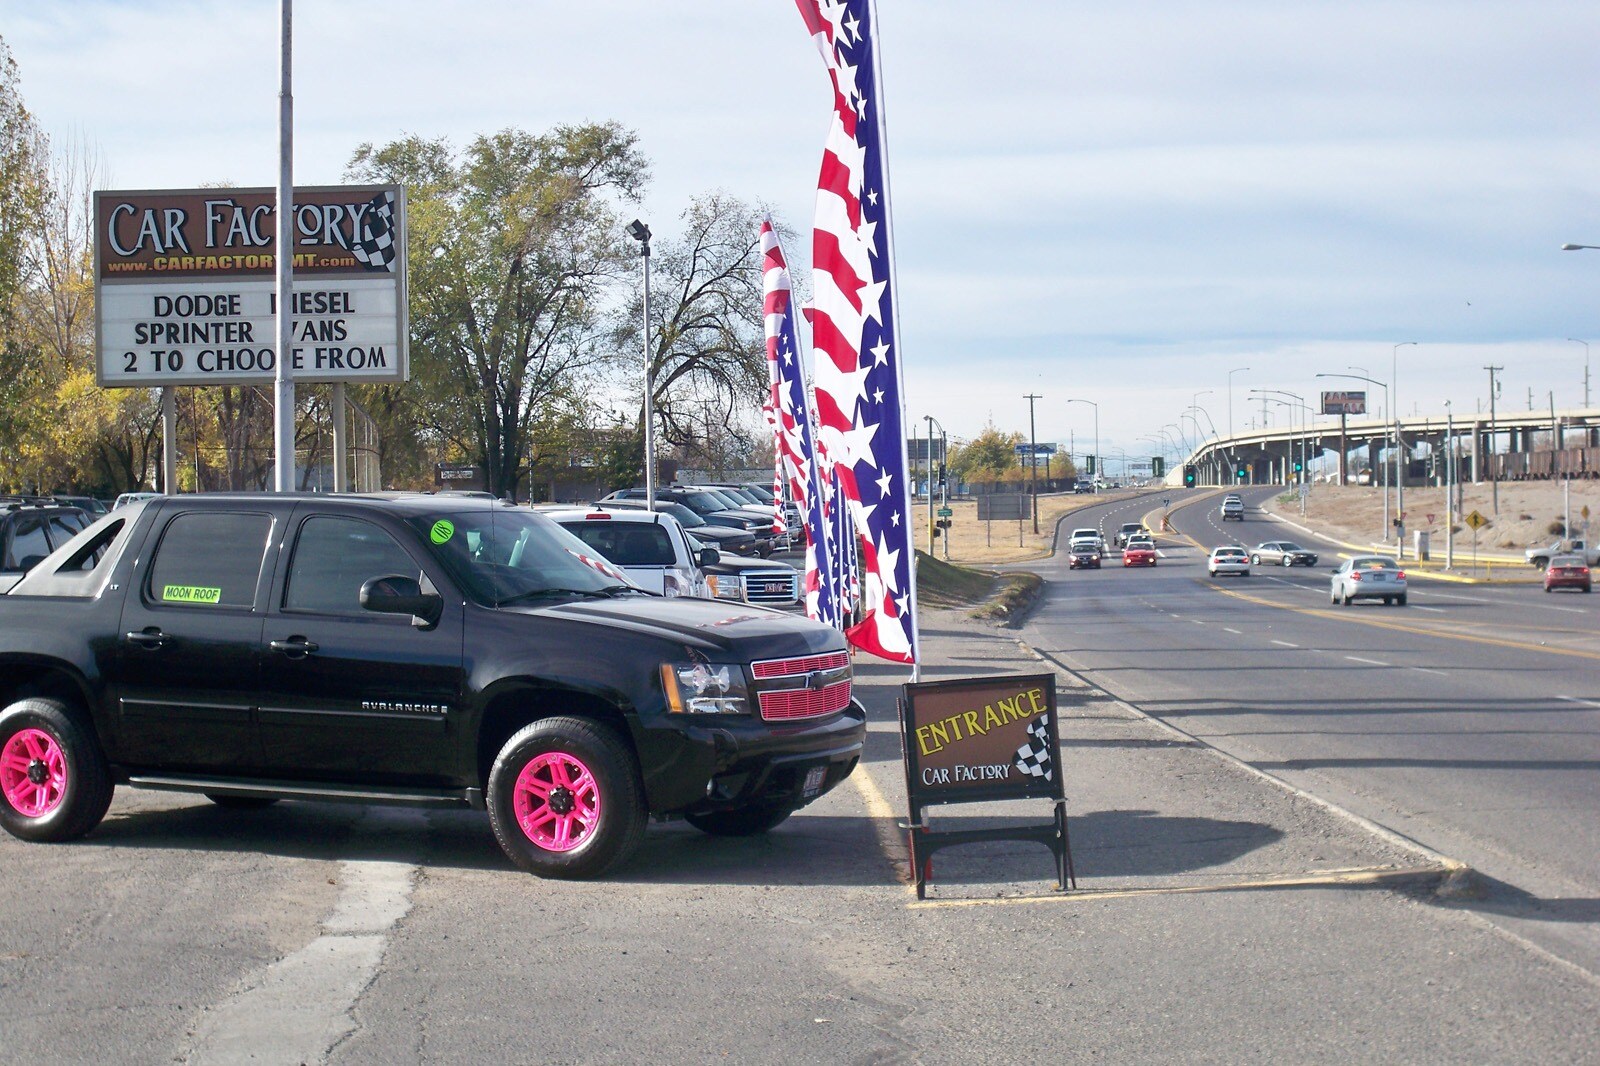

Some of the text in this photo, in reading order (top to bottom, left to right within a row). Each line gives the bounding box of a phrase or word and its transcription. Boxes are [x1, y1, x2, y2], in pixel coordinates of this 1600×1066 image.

[108, 203, 190, 256] CAR
[108, 253, 355, 272] www.CARFACTORMT.com
[154, 291, 355, 317] DODGE IESEL
[135, 321, 254, 345] SPRINTER
[123, 351, 138, 373] 2
[197, 348, 304, 372] CHOOE
[315, 346, 387, 370] FROM
[165, 587, 219, 600] MOON ROOF
[361, 701, 438, 713] AVALANCHE
[915, 688, 1048, 756] ENTRANCE
[922, 764, 1011, 786] CAR FACTORY
